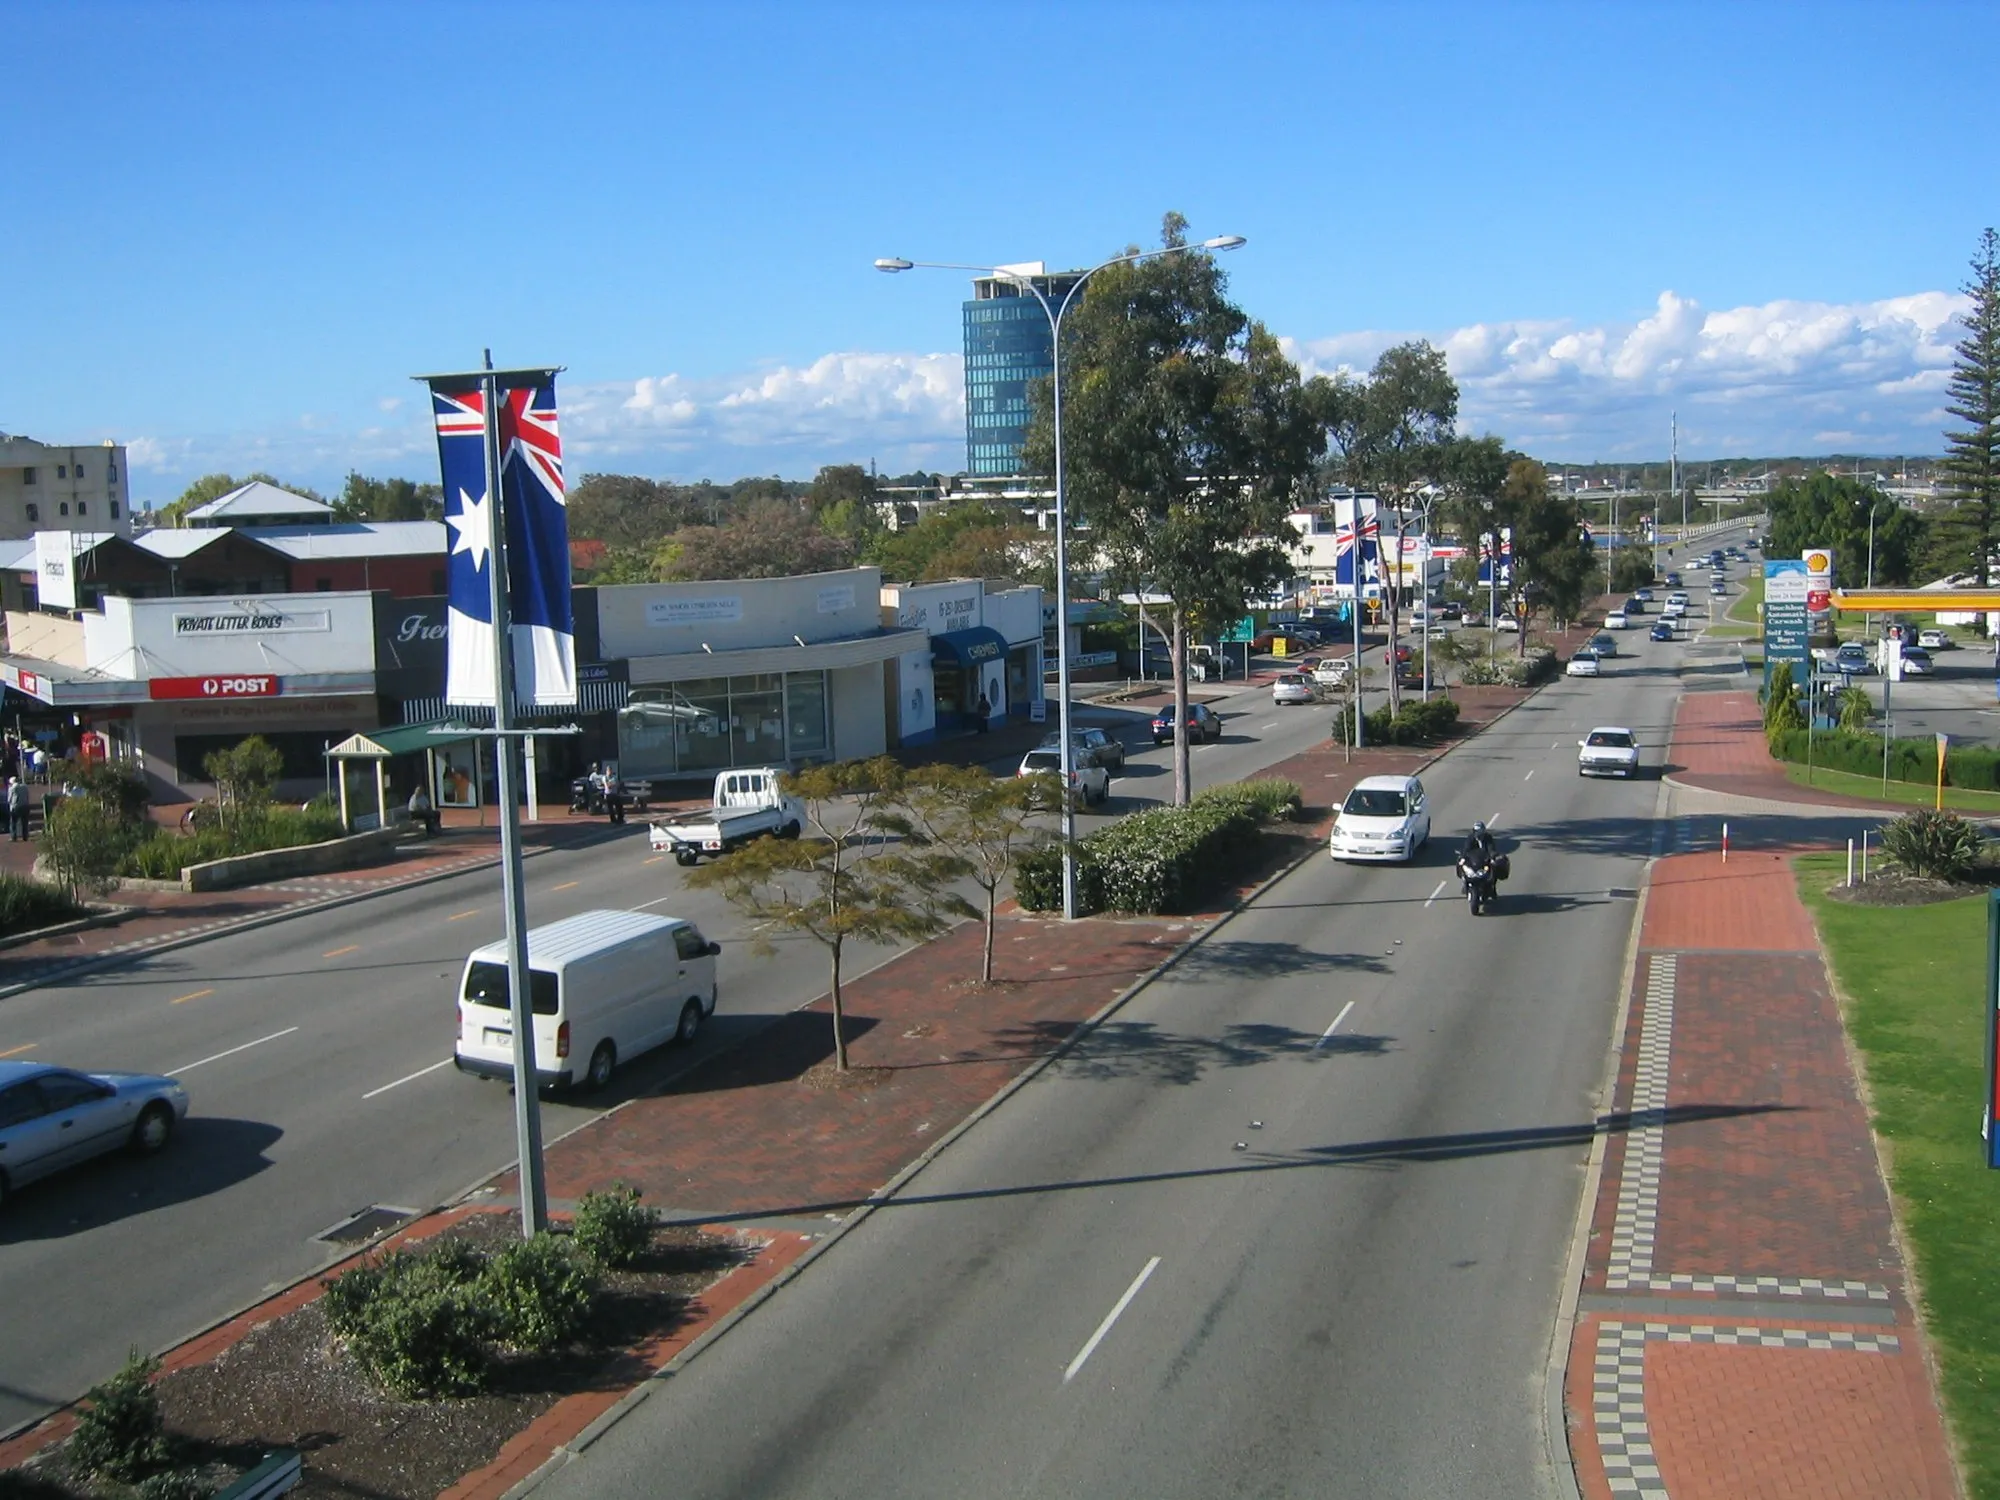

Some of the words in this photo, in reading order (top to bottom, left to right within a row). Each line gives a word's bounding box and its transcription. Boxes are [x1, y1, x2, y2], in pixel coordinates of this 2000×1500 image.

[177, 615, 214, 633] PRIVATE
[215, 615, 250, 630] LETTER
[251, 615, 283, 630] BOXES
[968, 642, 1000, 660] CHEMIST
[222, 678, 270, 693] POST
